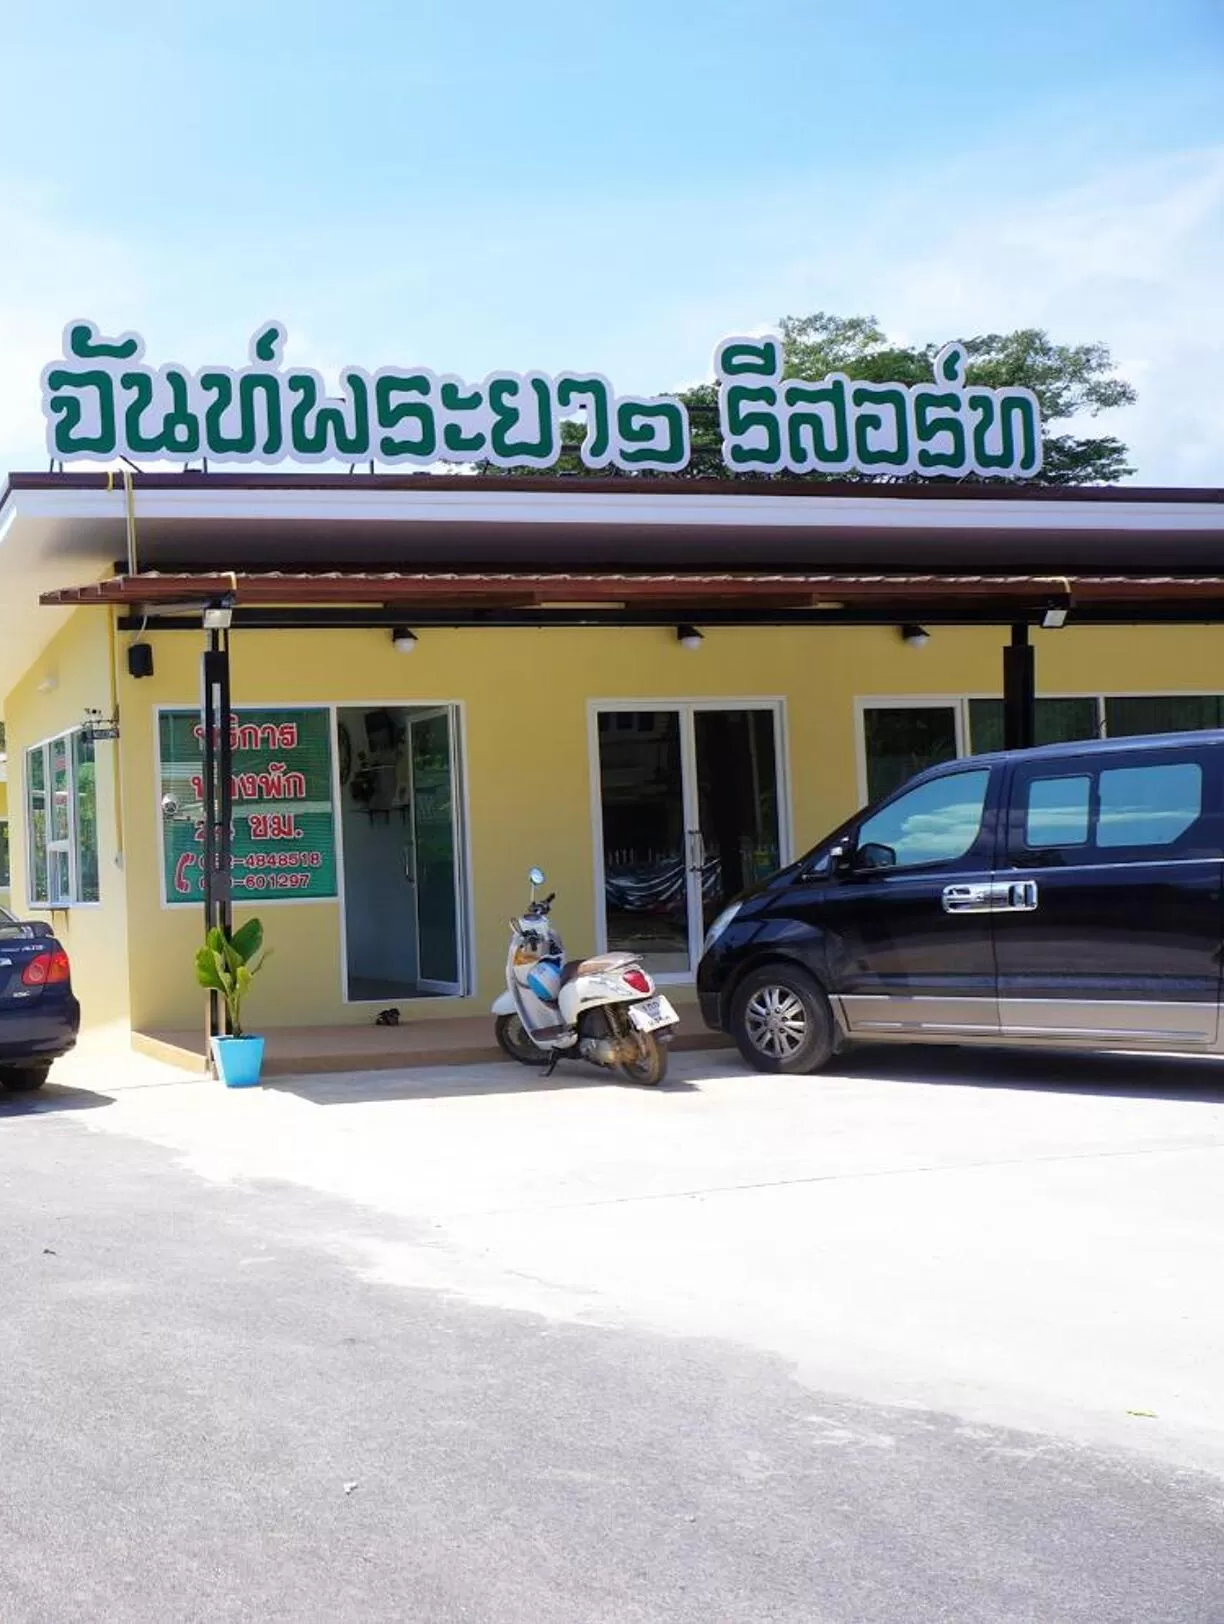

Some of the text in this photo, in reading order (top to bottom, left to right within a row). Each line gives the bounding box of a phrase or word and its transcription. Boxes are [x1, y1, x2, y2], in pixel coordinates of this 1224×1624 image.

[719, 340, 1038, 472] รีสอร์ท
[191, 762, 306, 800] งพัก
[198, 852, 321, 870] -4848518
[199, 873, 310, 890] -601297
